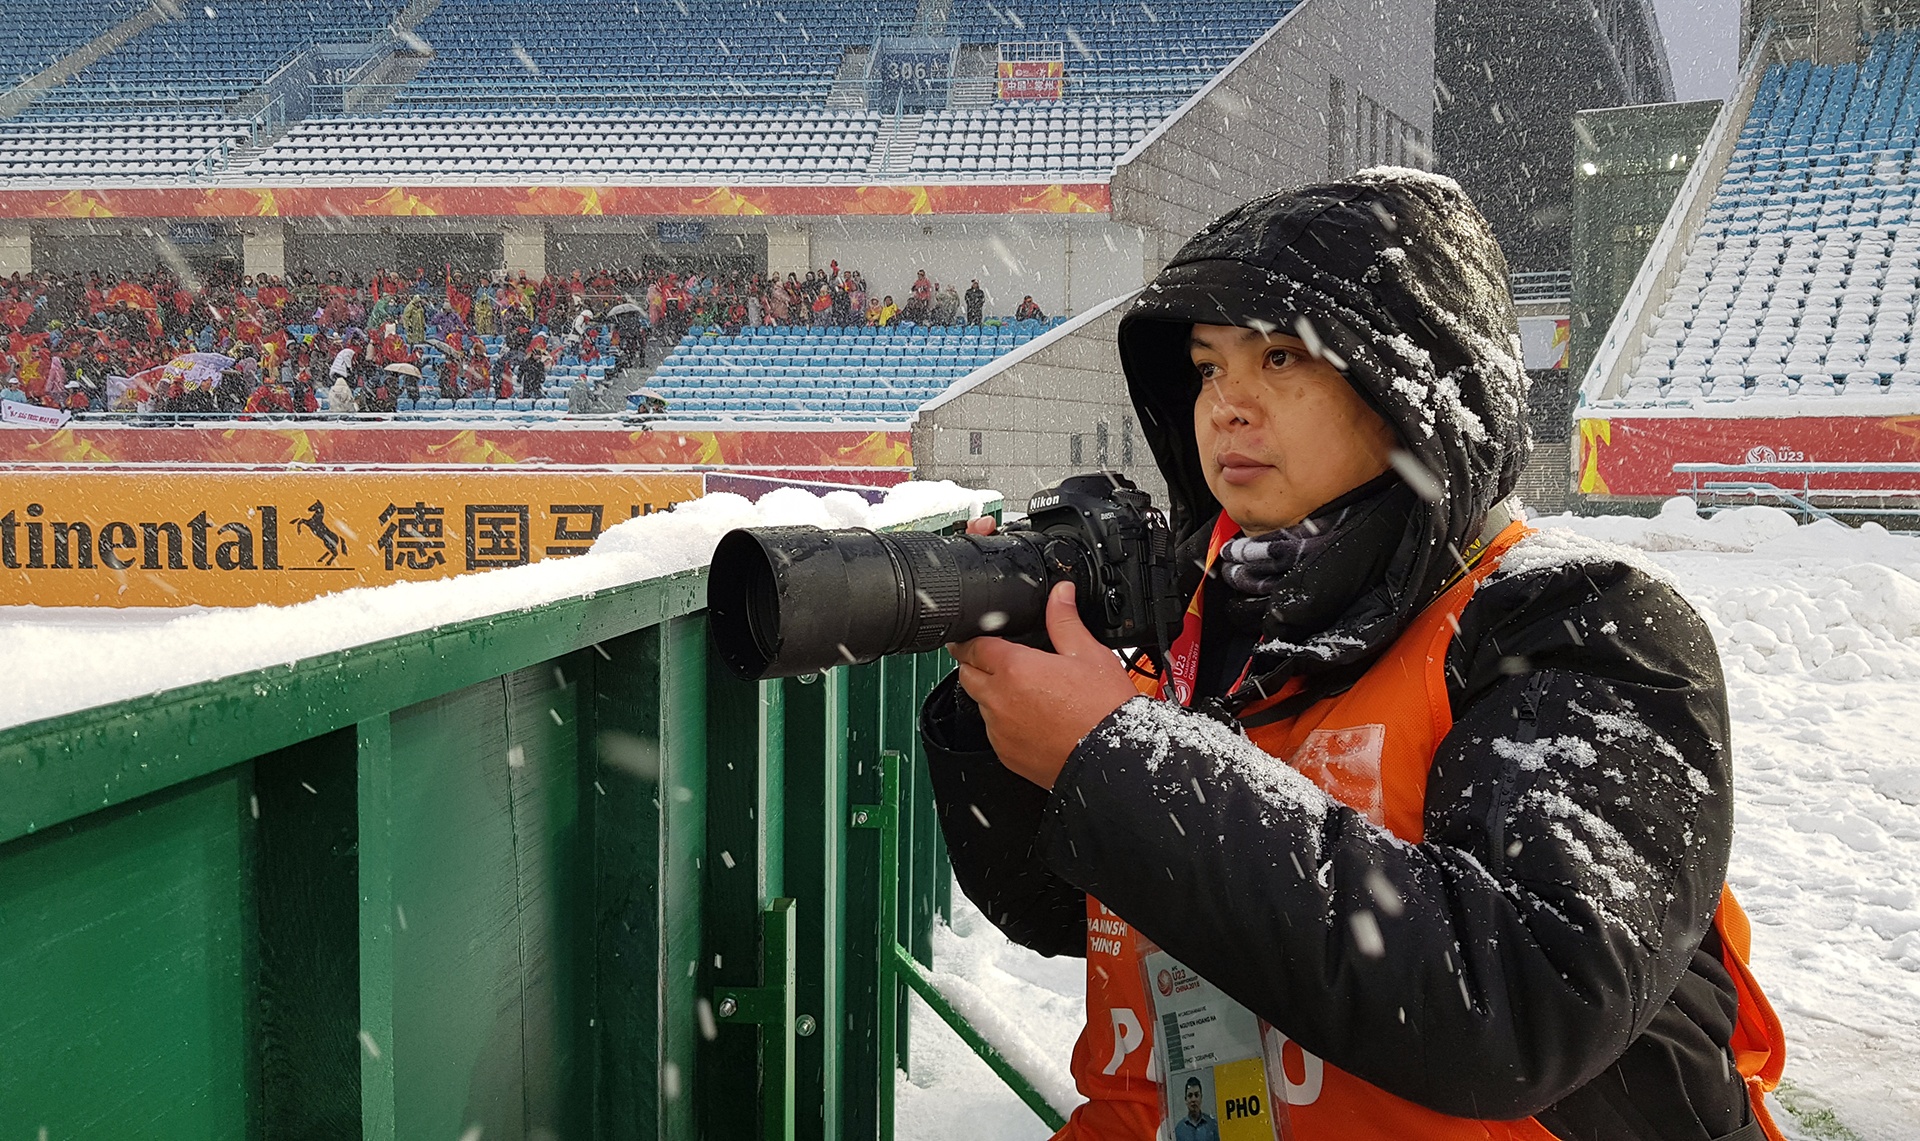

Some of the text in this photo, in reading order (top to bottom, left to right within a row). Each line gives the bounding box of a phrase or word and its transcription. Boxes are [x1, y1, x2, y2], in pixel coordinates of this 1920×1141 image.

[889, 62, 926, 80] 306
[1778, 451, 1804, 462] U23
[1029, 495, 1060, 510] Nikon
[0, 503, 284, 571] tinental
[1173, 654, 1187, 676] U23
[1188, 643, 1200, 680] CHINA 2018
[1172, 969, 1187, 981] U23
[1225, 1094, 1261, 1120] PHO
